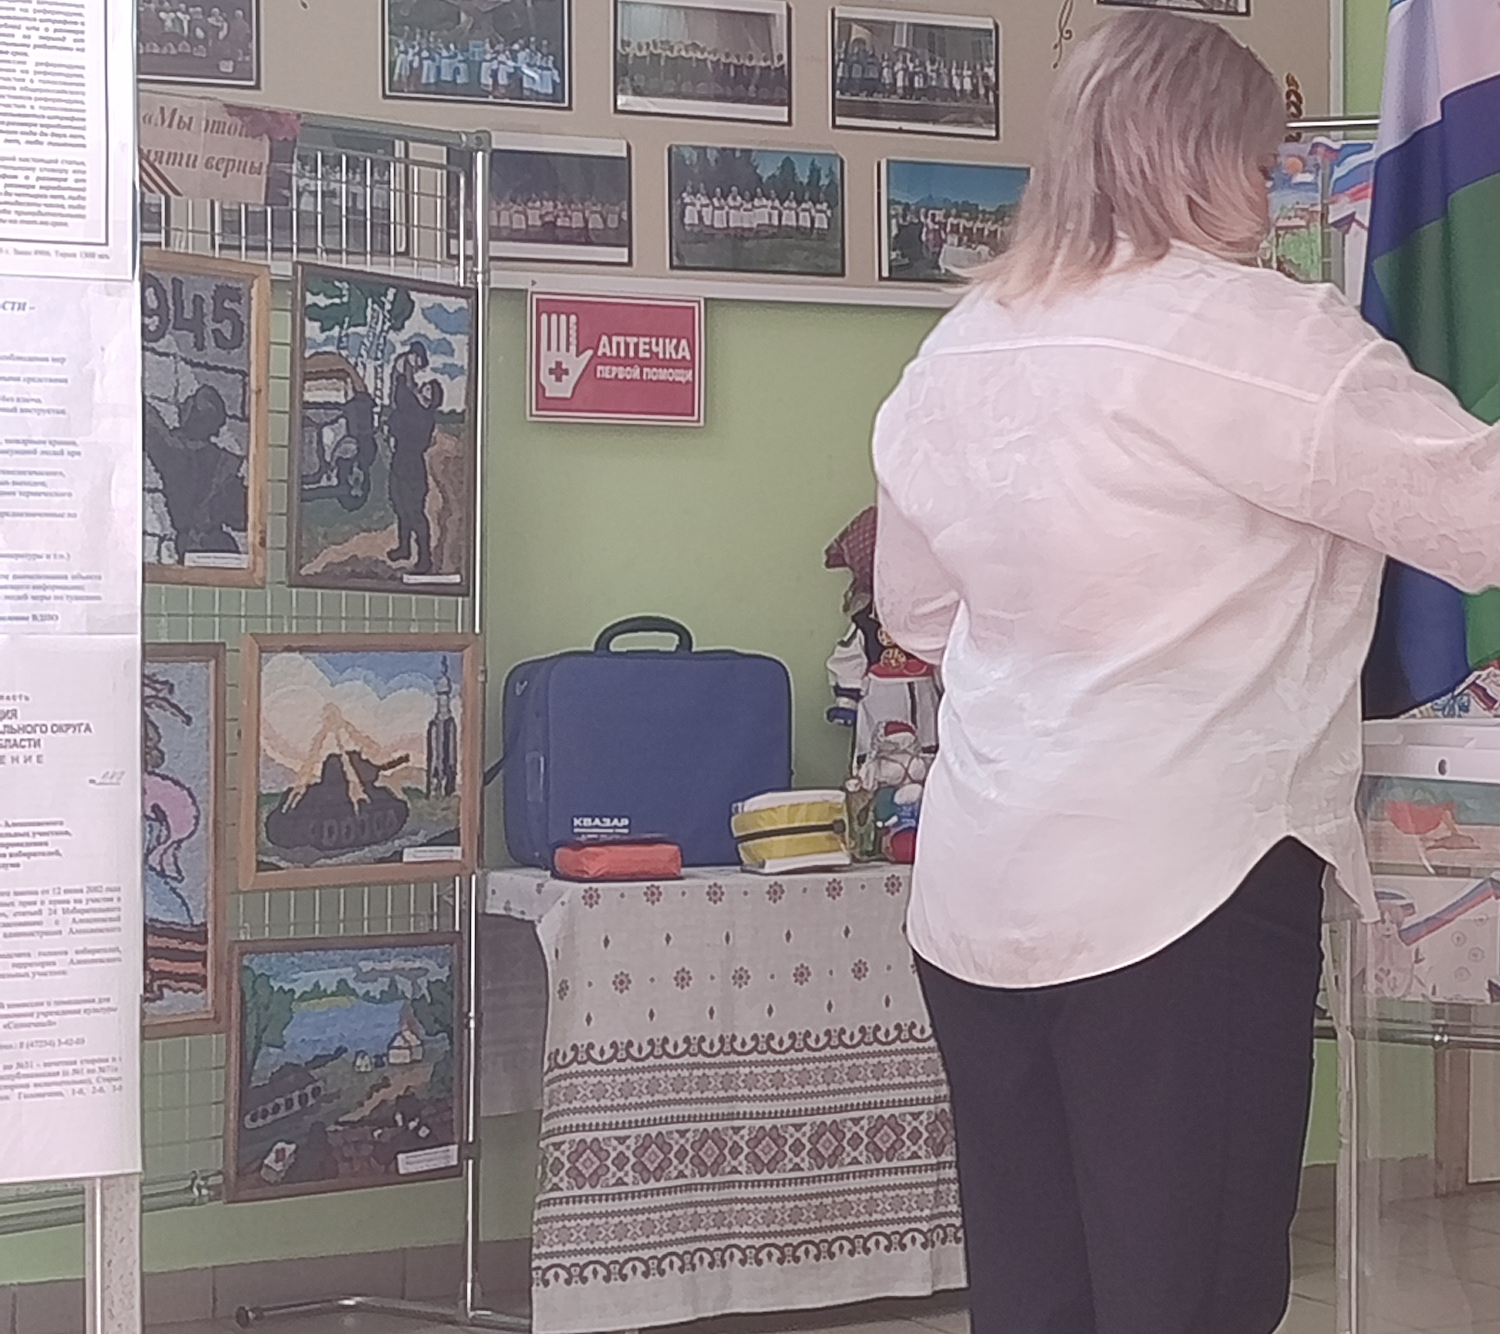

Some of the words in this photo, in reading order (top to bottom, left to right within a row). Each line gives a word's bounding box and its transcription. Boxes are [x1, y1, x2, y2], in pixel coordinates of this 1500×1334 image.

[142, 105, 194, 132] «Мы
[204, 155, 264, 179] верны
[597, 334, 692, 361] АПТЕЧКА
[595, 364, 641, 381] ПЕРВОЙ
[642, 366, 693, 385] ПОМОЩИ
[0, 722, 49, 735] ЛЬНОГО
[573, 817, 630, 828] КВАЗАР
